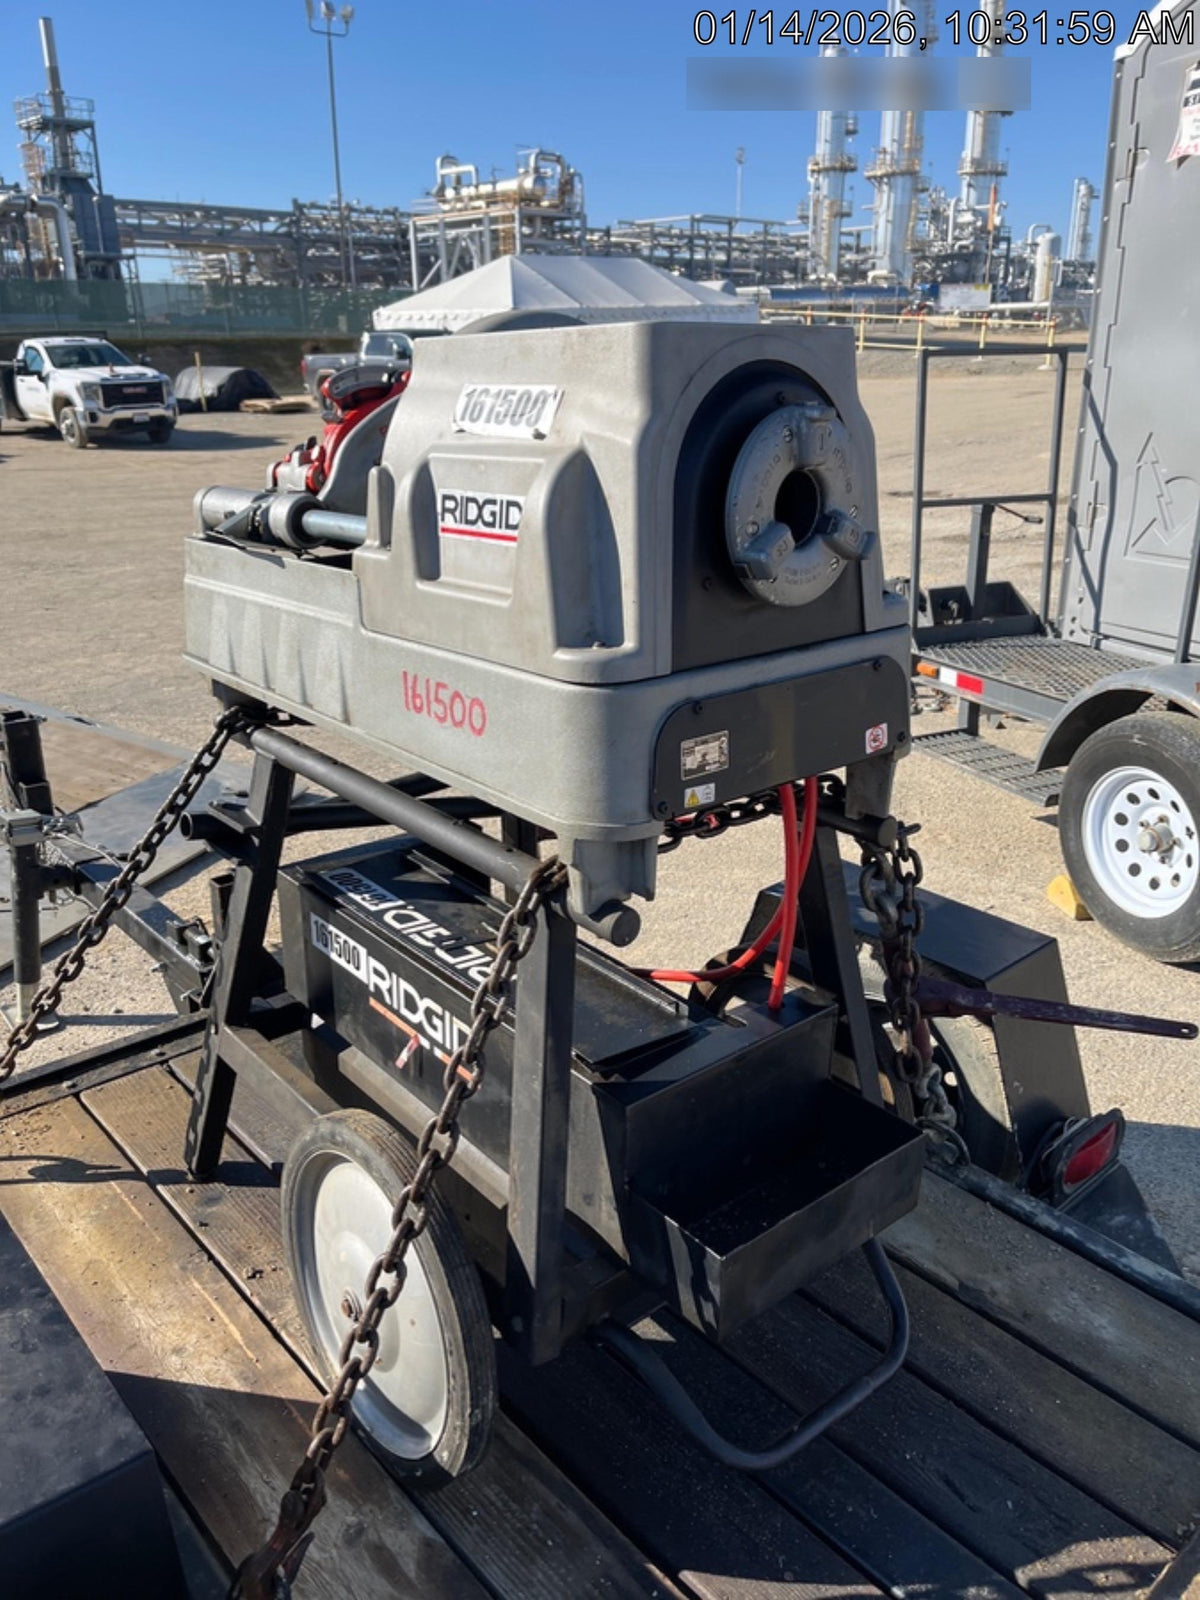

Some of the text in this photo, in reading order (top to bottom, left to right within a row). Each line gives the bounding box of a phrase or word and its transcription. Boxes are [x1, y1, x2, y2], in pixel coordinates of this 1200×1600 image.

[459, 387, 548, 427] 161500
[440, 494, 523, 531] RIDGID
[402, 669, 486, 737] 161500
[313, 918, 361, 972] 161500
